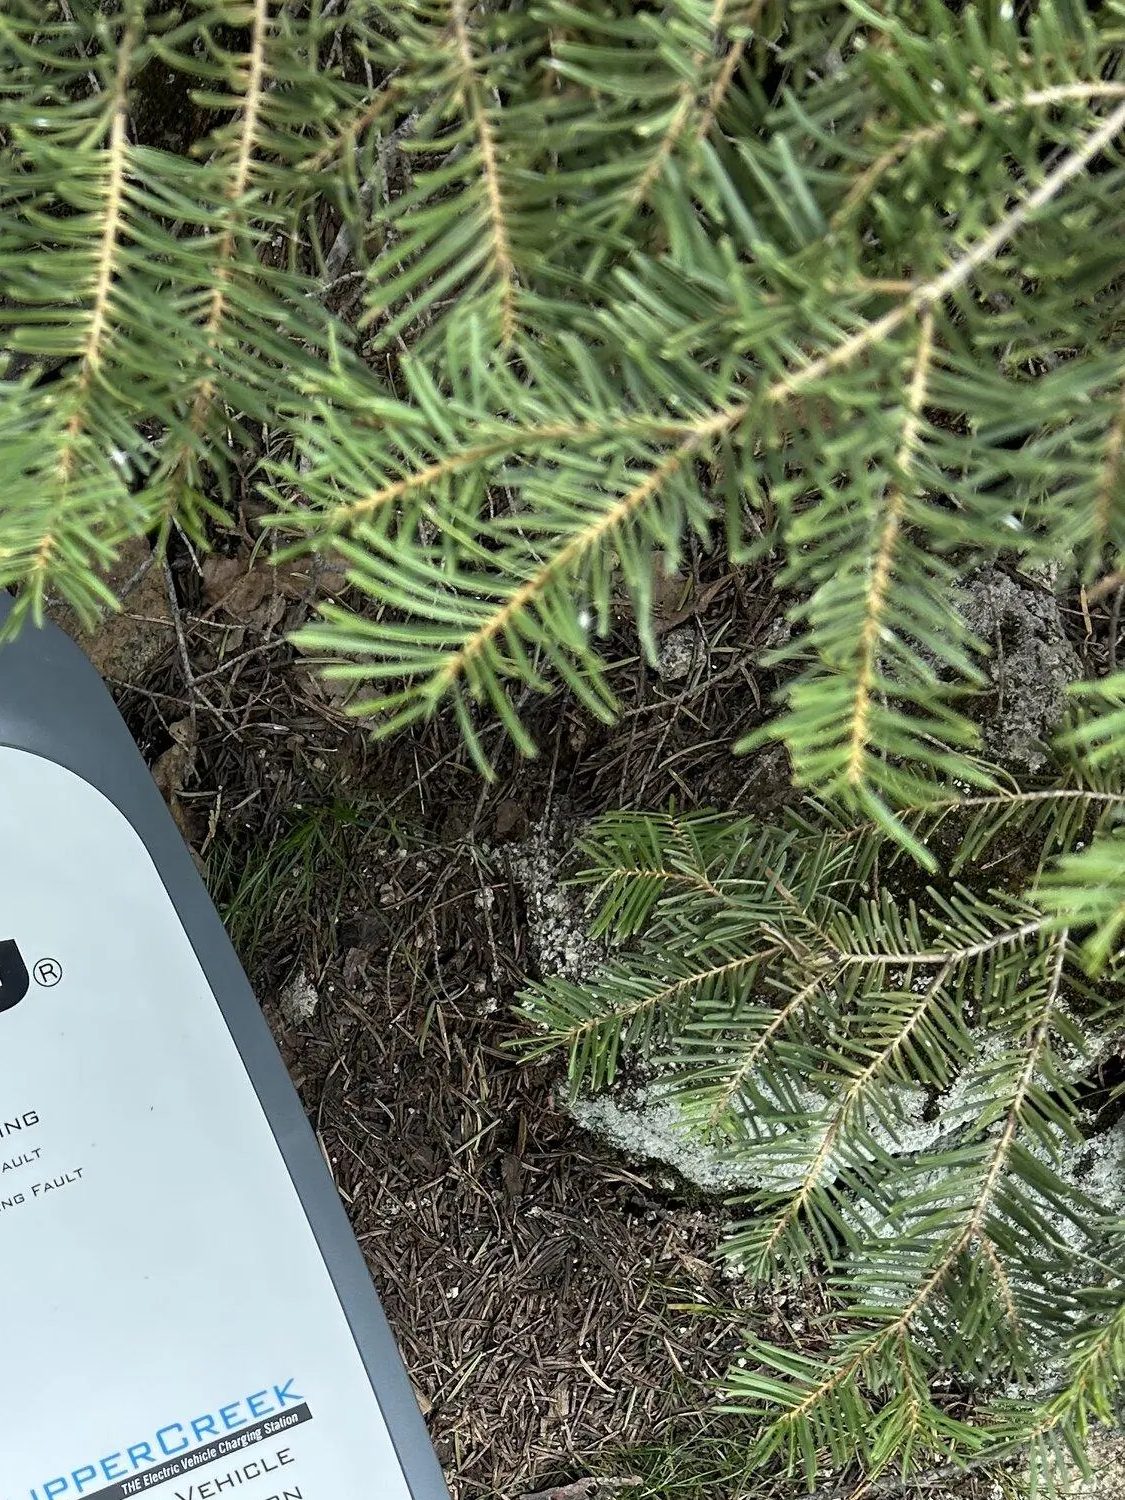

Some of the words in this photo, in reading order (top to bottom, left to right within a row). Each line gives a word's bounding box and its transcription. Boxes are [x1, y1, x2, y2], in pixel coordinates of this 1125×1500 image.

[30, 1167, 83, 1197] FAULT
[120, 1477, 142, 1495] THE
[142, 1464, 180, 1487] Electric
[180, 1448, 217, 1470] Vehicle
[218, 1428, 265, 1454] Charging
[263, 1413, 299, 1435] Station
